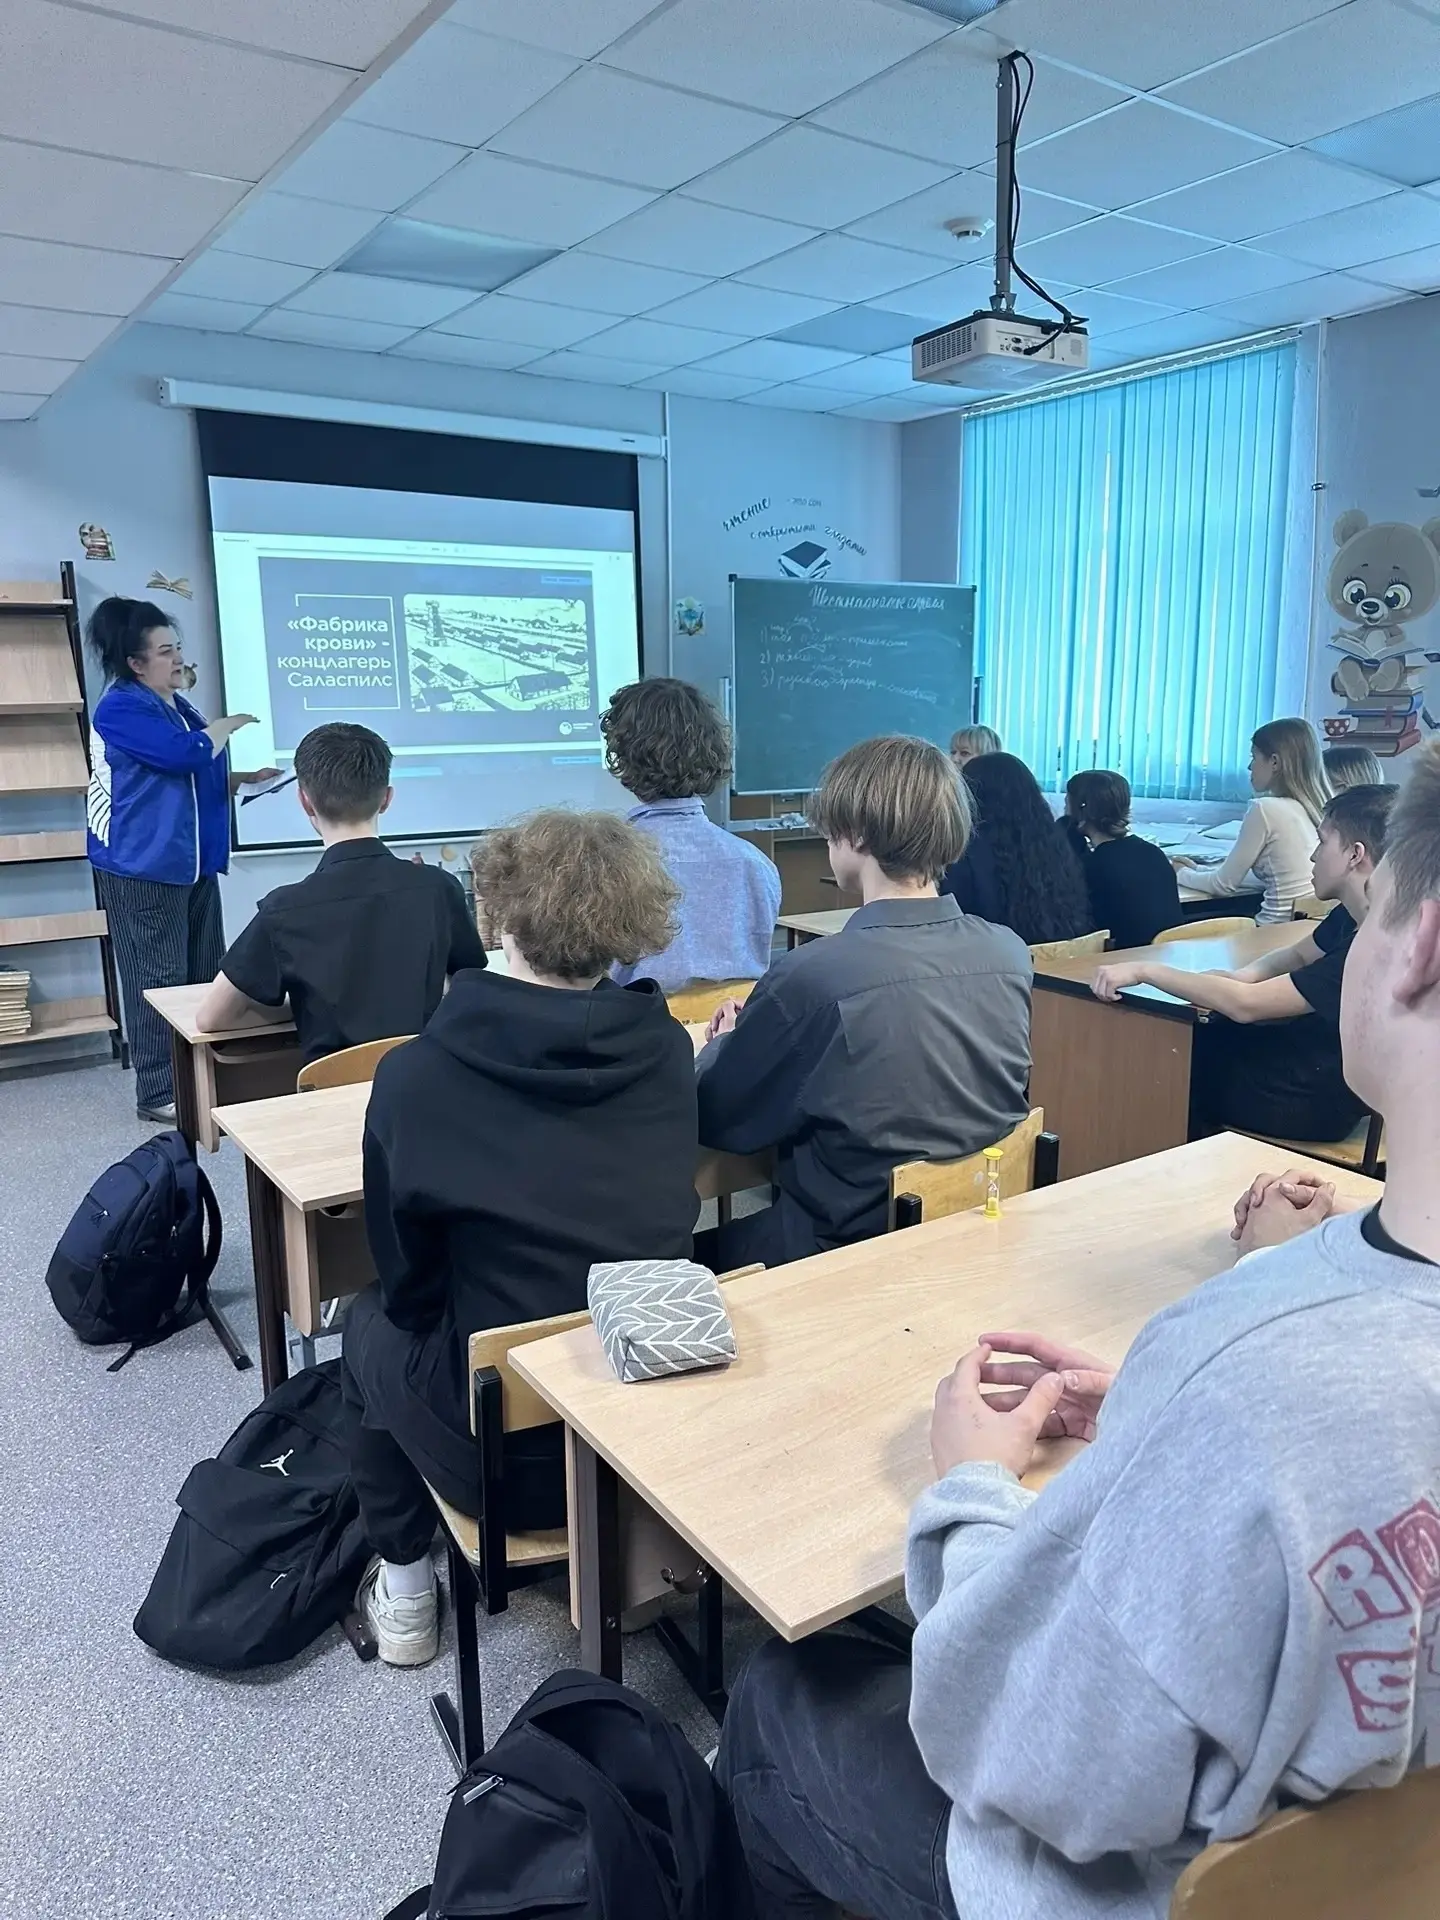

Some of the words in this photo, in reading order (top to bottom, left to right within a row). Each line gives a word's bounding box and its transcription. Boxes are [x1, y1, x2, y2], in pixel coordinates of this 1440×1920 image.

[287, 616, 389, 635] «Фабрика
[304, 637, 377, 652] крови»
[277, 656, 392, 671] концлагерь
[287, 671, 393, 687] Саласпилс
